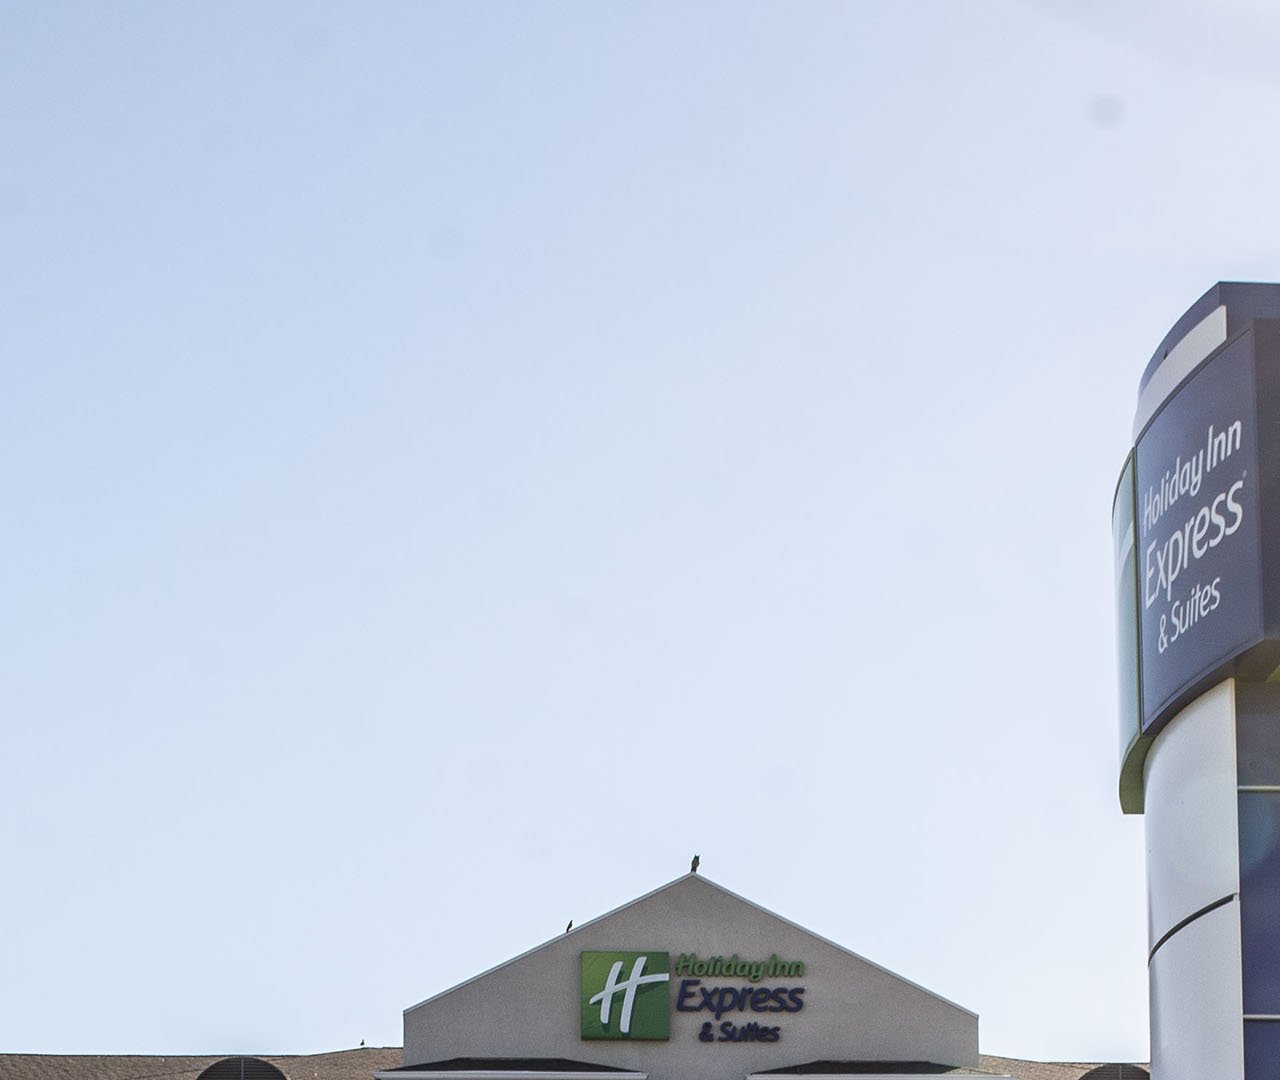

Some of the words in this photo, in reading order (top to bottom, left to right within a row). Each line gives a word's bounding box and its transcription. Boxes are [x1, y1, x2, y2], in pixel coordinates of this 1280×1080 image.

[1143, 449, 1204, 537] Holiday
[1206, 420, 1242, 473] Inn
[1146, 480, 1243, 609] Express
[1158, 614, 1168, 653] &
[1171, 577, 1221, 642] Suites
[675, 953, 766, 982] Holiday
[768, 953, 806, 977] Inn
[676, 979, 806, 1020] Express
[698, 1021, 714, 1043] &
[718, 1020, 782, 1043] Suites
